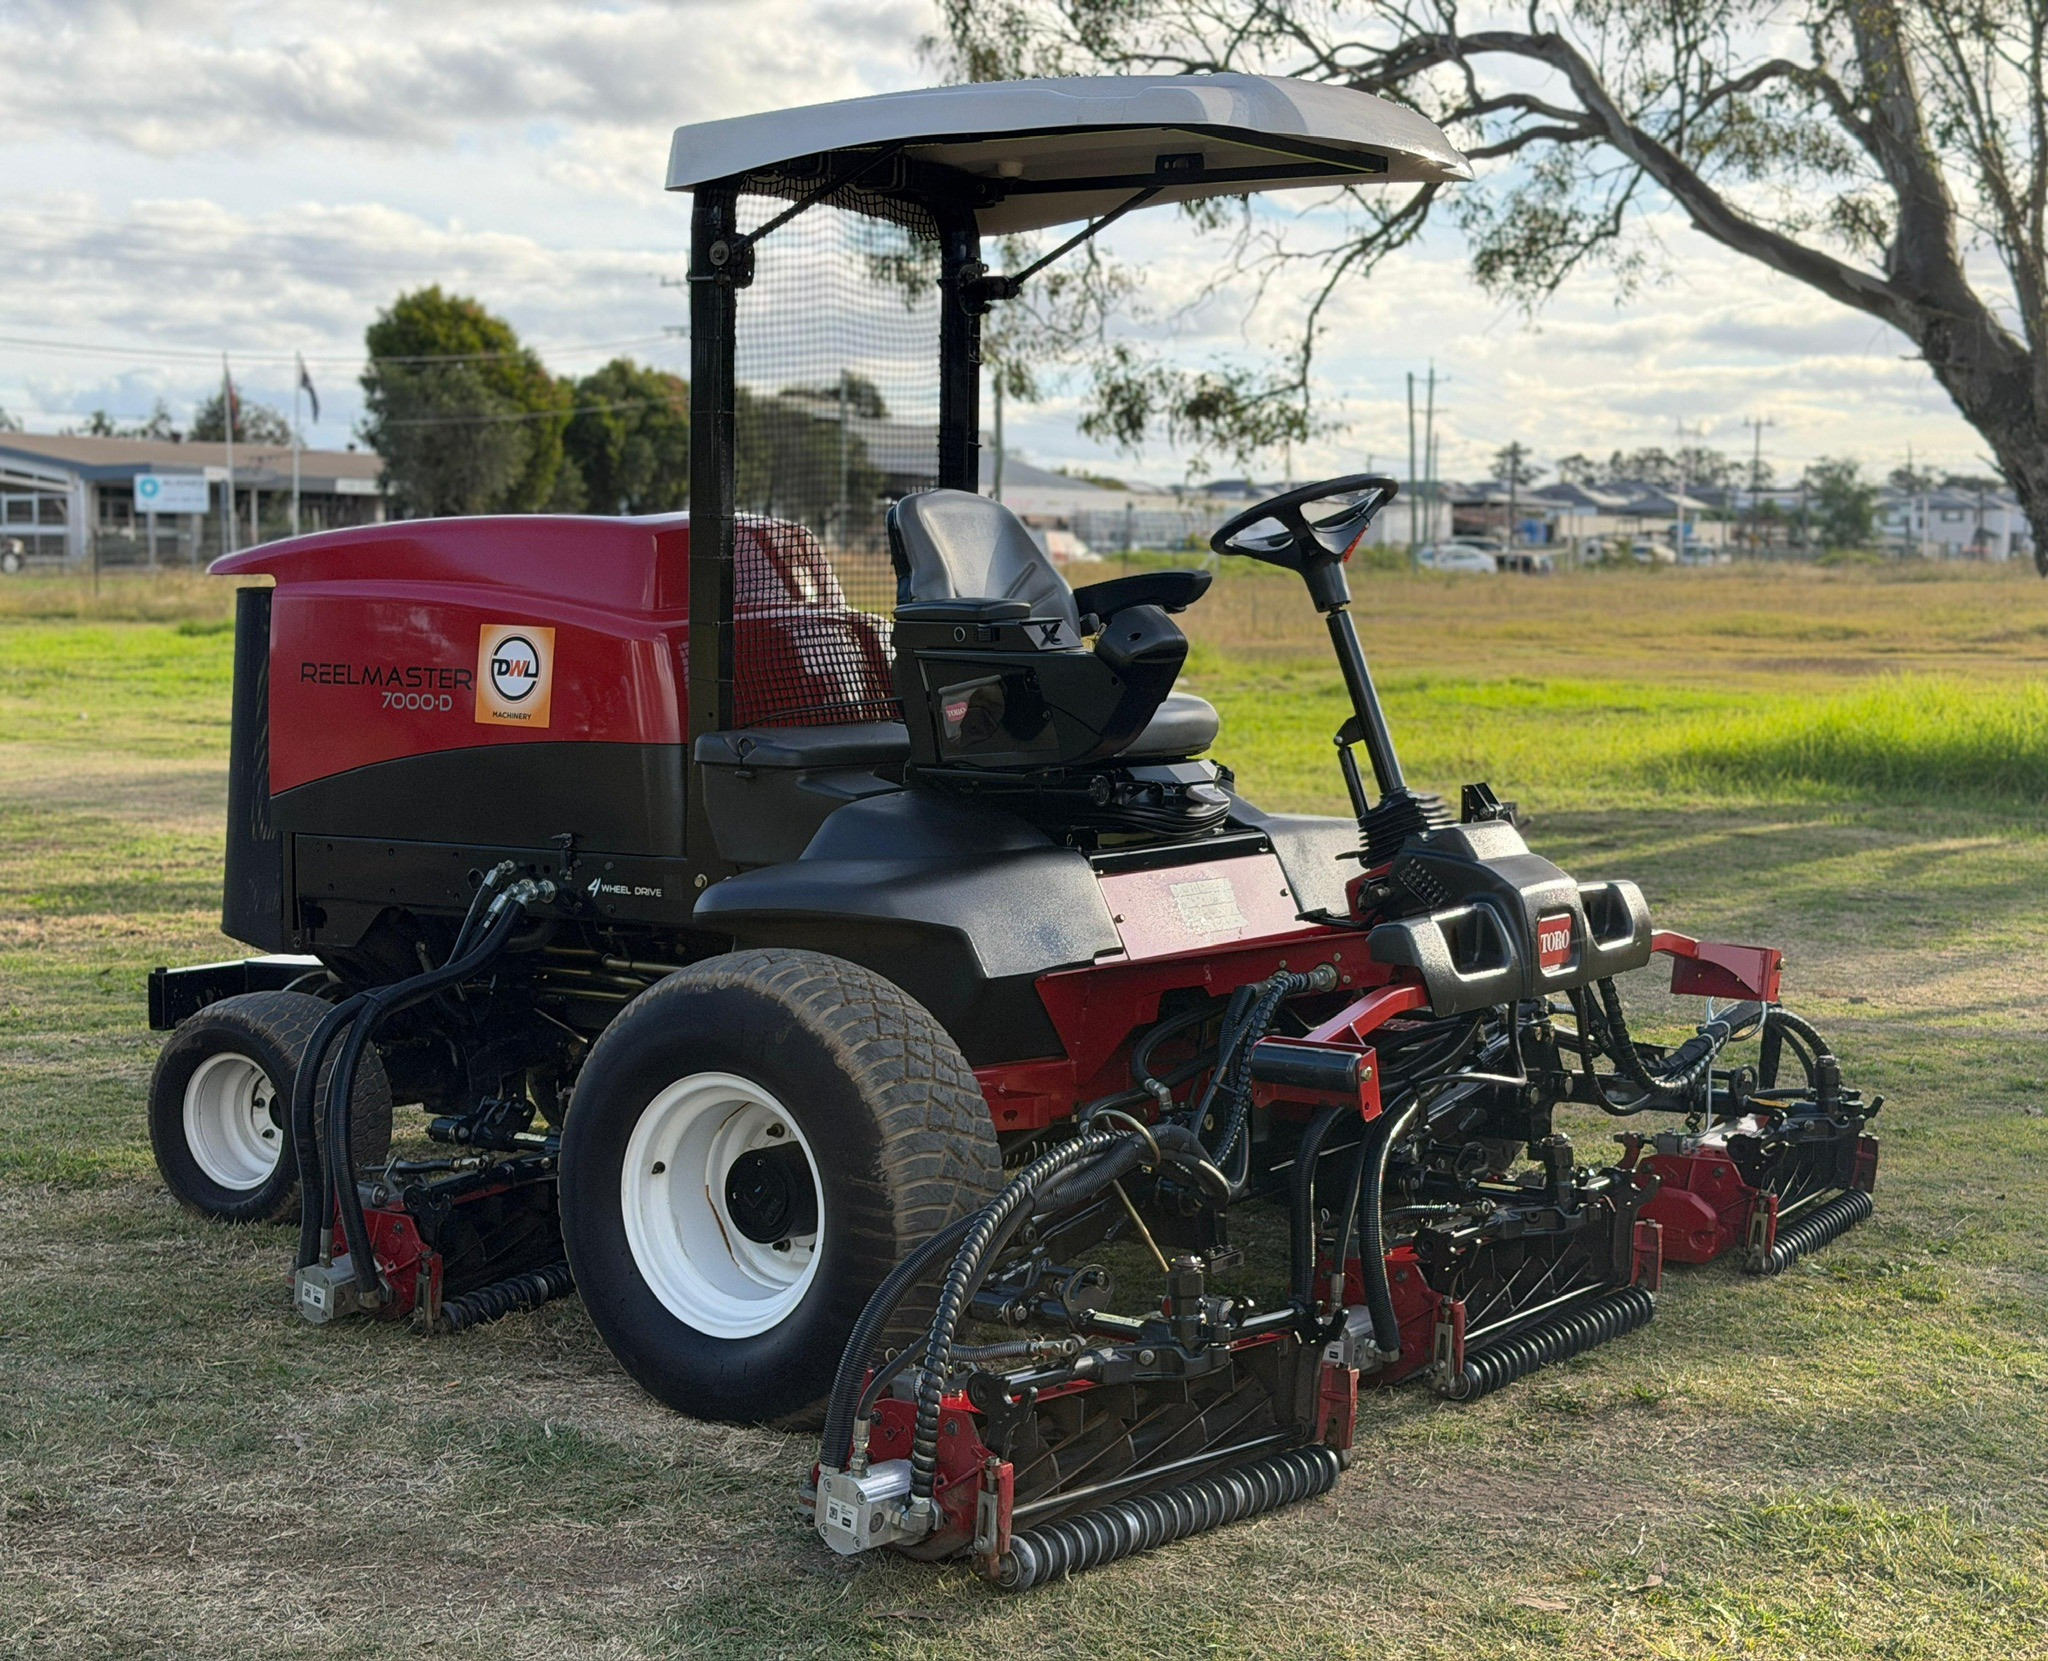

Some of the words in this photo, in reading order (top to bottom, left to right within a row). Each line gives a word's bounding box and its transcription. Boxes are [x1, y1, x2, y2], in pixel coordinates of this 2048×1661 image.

[301, 662, 473, 690] REELMASTER
[492, 658, 538, 678] DWL
[492, 710, 532, 720] MACHINERY
[587, 877, 602, 898] 4
[601, 884, 632, 895] WHEEL
[634, 886, 662, 898] DRIVE
[1540, 929, 1571, 953] TORO
